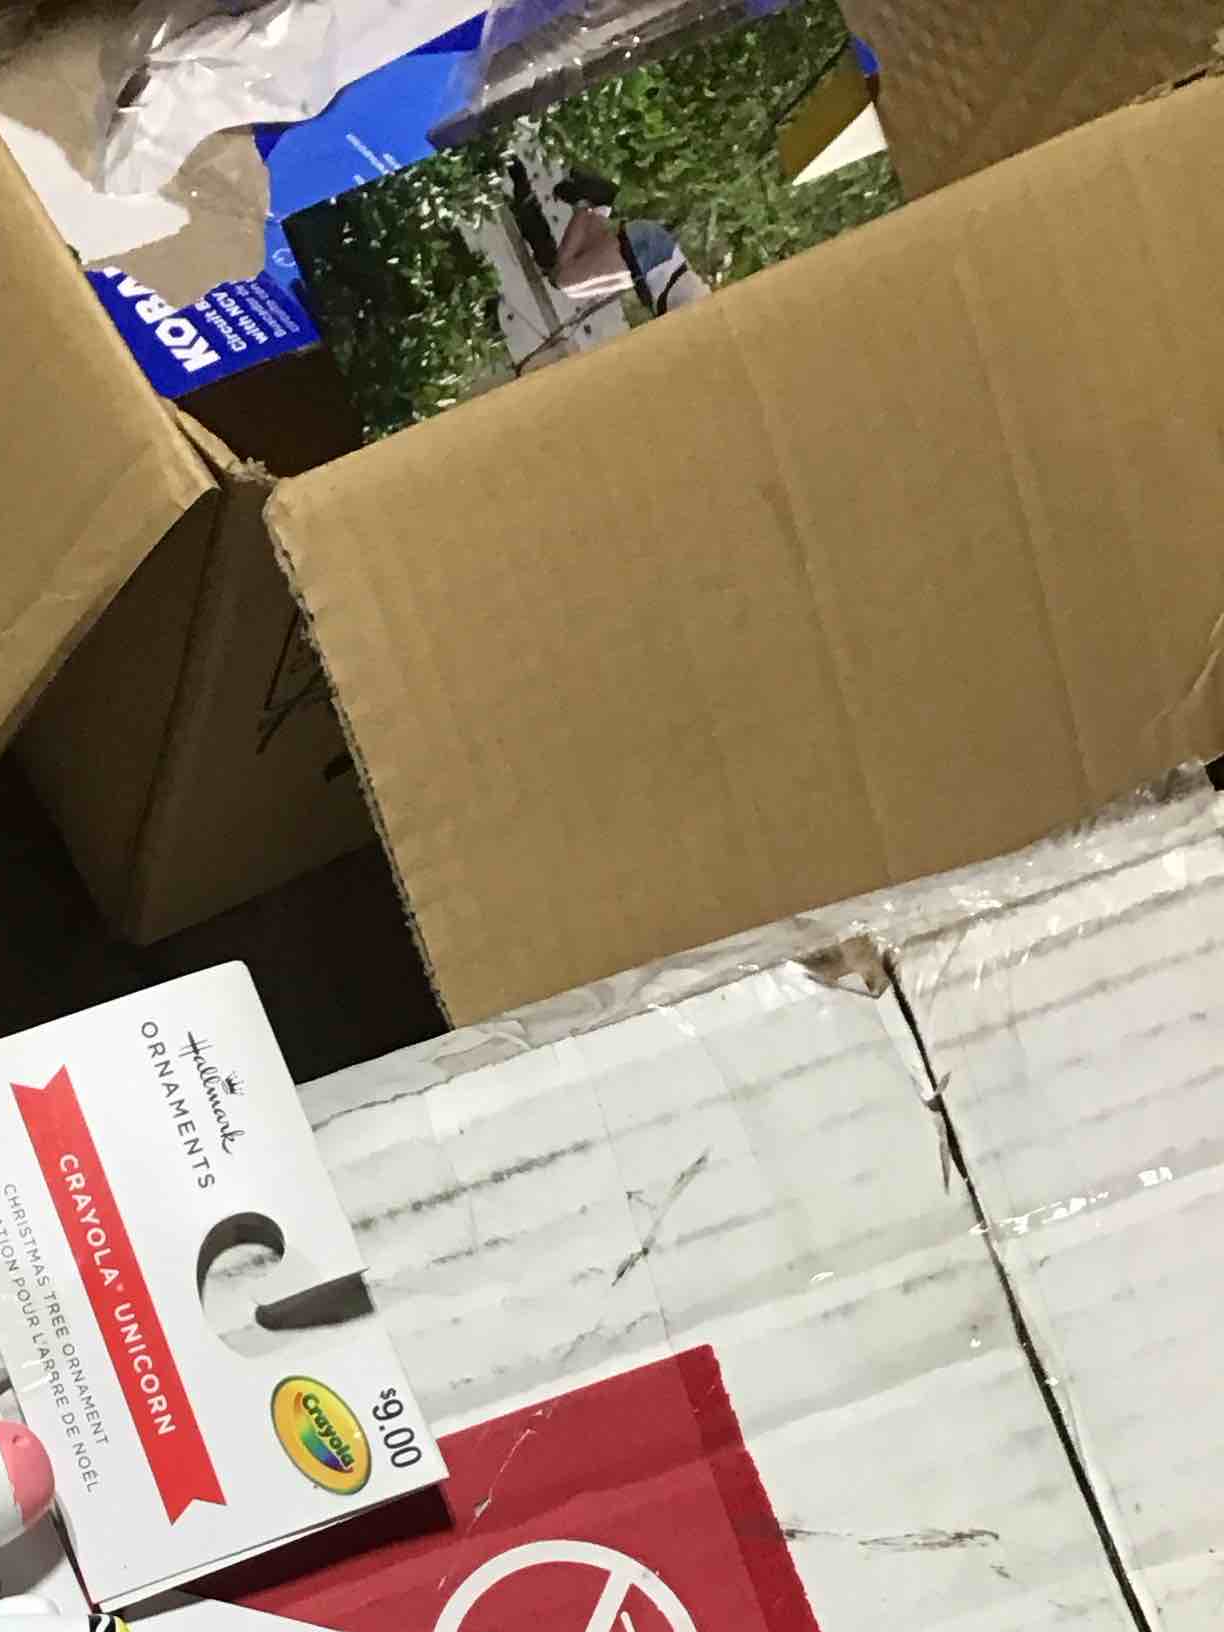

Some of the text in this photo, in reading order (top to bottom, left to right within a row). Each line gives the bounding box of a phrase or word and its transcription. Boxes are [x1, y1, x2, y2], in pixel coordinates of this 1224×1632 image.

[103, 266, 222, 373] KOBA
[203, 306, 247, 352] Circuit
[213, 291, 240, 321] NCV
[235, 312, 269, 345] with
[141, 1022, 215, 1188] ORNAMENTS
[180, 1032, 244, 1153] Hallmark
[4, 1184, 108, 1443] CHRISTMAS TREE ORNAMENT
[12, 1278, 39, 1327] POUR
[62, 1412, 80, 1437] DE
[115, 1303, 175, 1434] UNICORN
[299, 1392, 355, 1470] Crayola
[371, 1387, 423, 1469] $9.00
